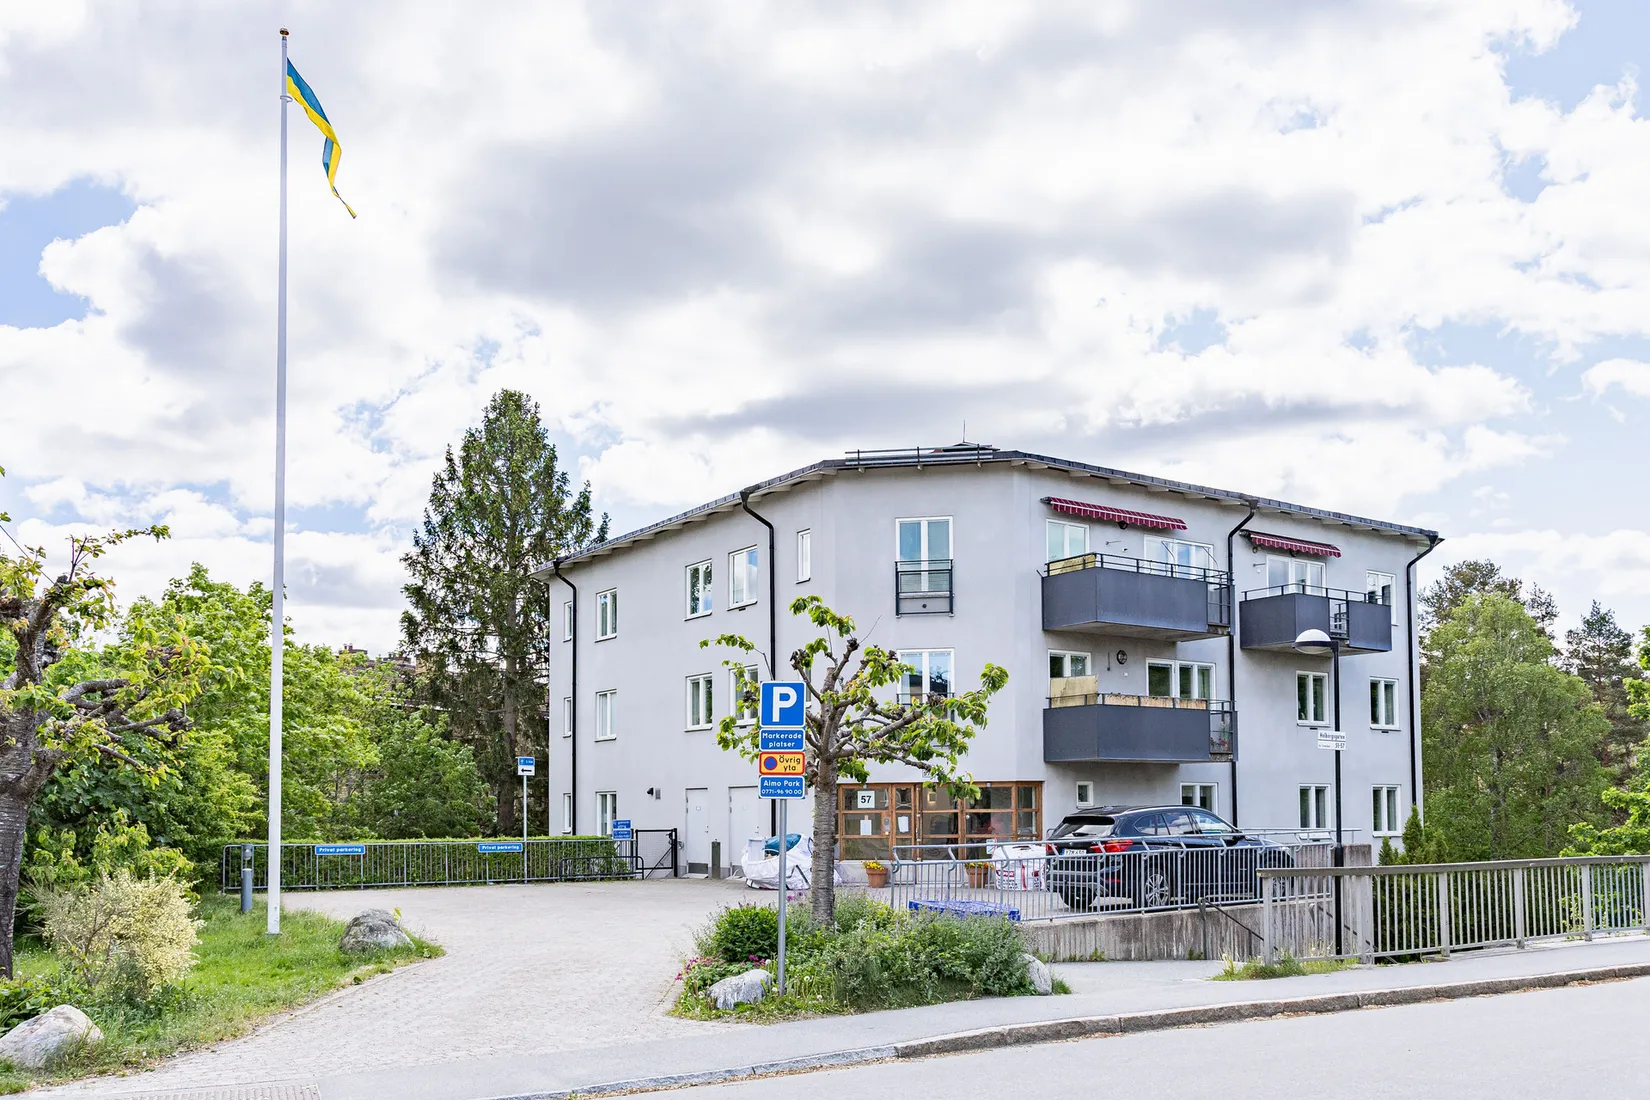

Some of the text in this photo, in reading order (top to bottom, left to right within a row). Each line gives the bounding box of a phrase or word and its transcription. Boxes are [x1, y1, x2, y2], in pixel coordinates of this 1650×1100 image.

[773, 686, 797, 722] P
[779, 755, 801, 764] Övrig
[860, 796, 872, 804] 57
